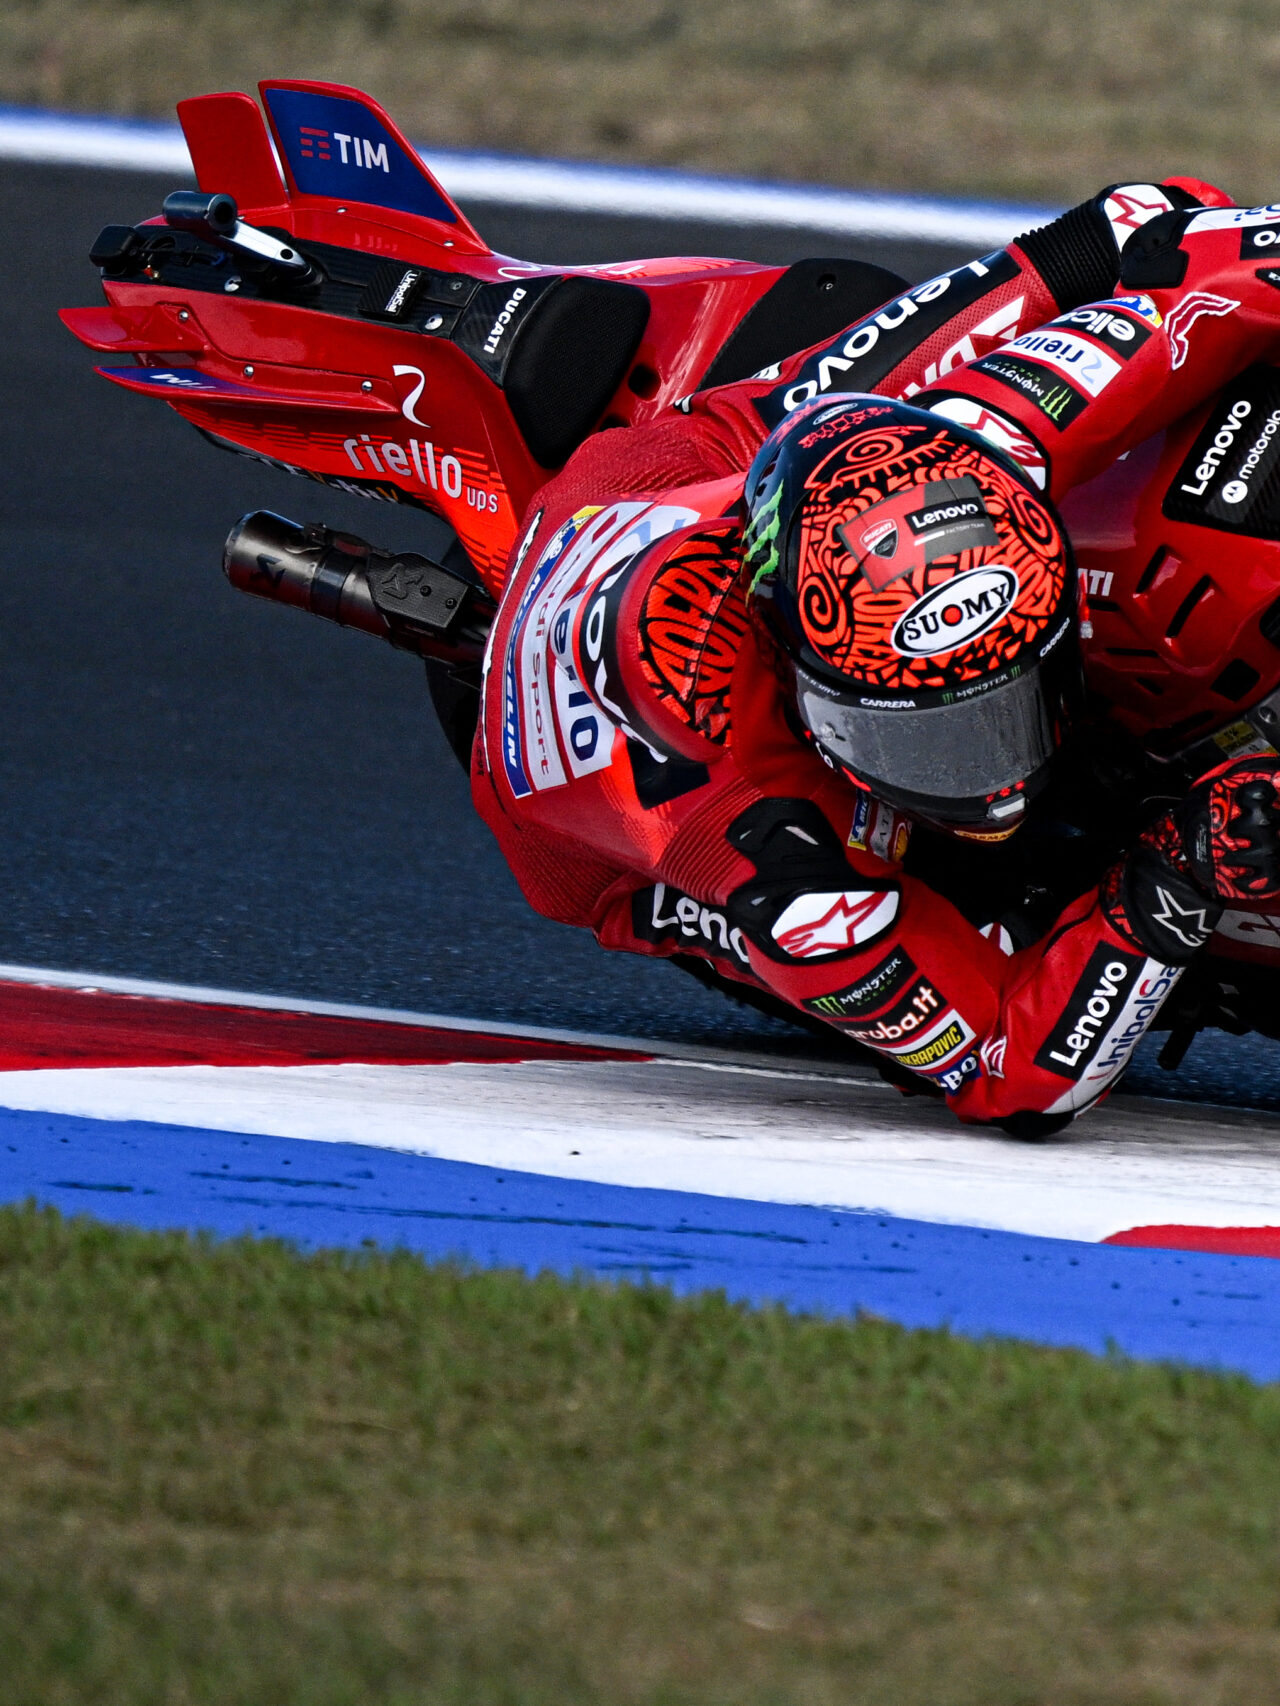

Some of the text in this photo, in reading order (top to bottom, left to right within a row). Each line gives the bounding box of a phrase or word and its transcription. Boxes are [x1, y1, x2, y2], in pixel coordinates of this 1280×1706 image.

[333, 132, 389, 173] TIM
[483, 287, 527, 354] DUCATI
[783, 260, 990, 412] Lenovo
[1013, 336, 1085, 363] riello
[982, 361, 1044, 397] MONSTER
[343, 433, 462, 498] riello
[466, 484, 498, 513] ups
[1180, 400, 1252, 496] Lenovo
[911, 503, 978, 528] Lenovo
[903, 583, 1010, 640] SUOMY
[530, 653, 550, 776] Sport
[860, 698, 916, 708] CARRERA
[651, 882, 750, 963] Leno
[840, 957, 902, 1005] MONSTER
[844, 985, 938, 1040] aruba.it
[1049, 961, 1128, 1067] Lenovo
[1095, 966, 1181, 1070] UnipolSa
